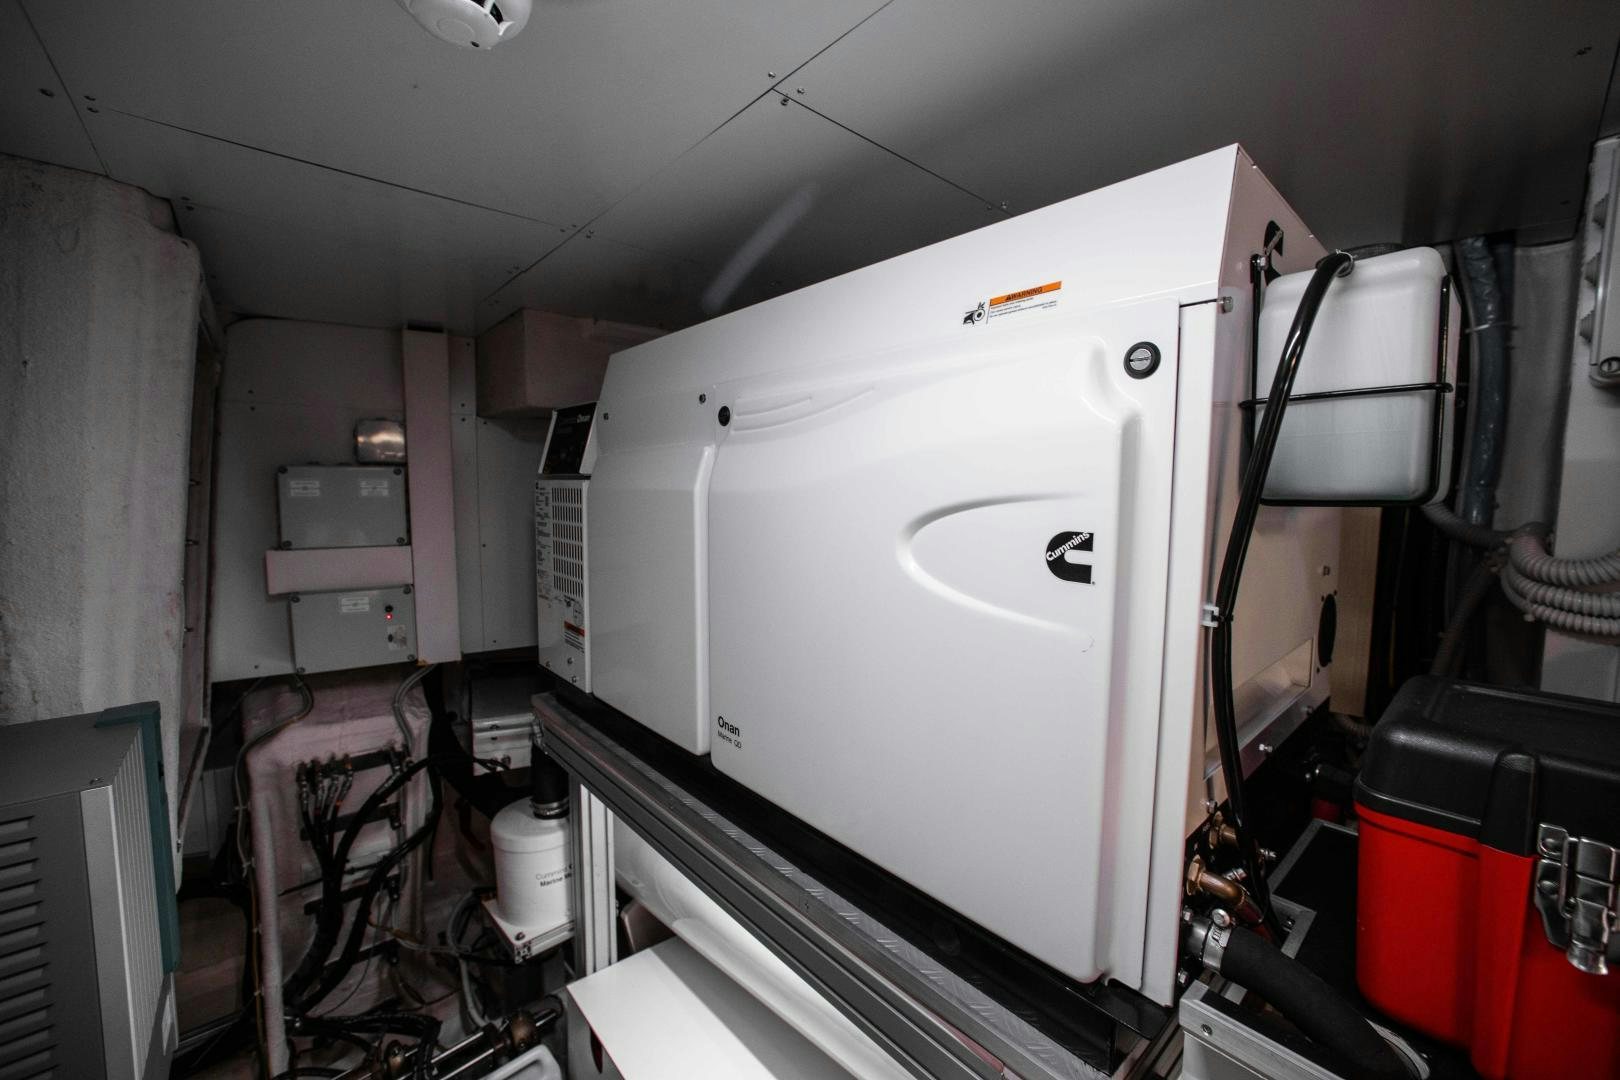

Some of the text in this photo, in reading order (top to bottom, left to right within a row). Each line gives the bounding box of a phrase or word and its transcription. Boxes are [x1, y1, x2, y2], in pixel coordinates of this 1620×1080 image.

[1011, 286, 1043, 300] WARNING
[1046, 531, 1090, 561] Cummins
[718, 715, 740, 737] Onan
